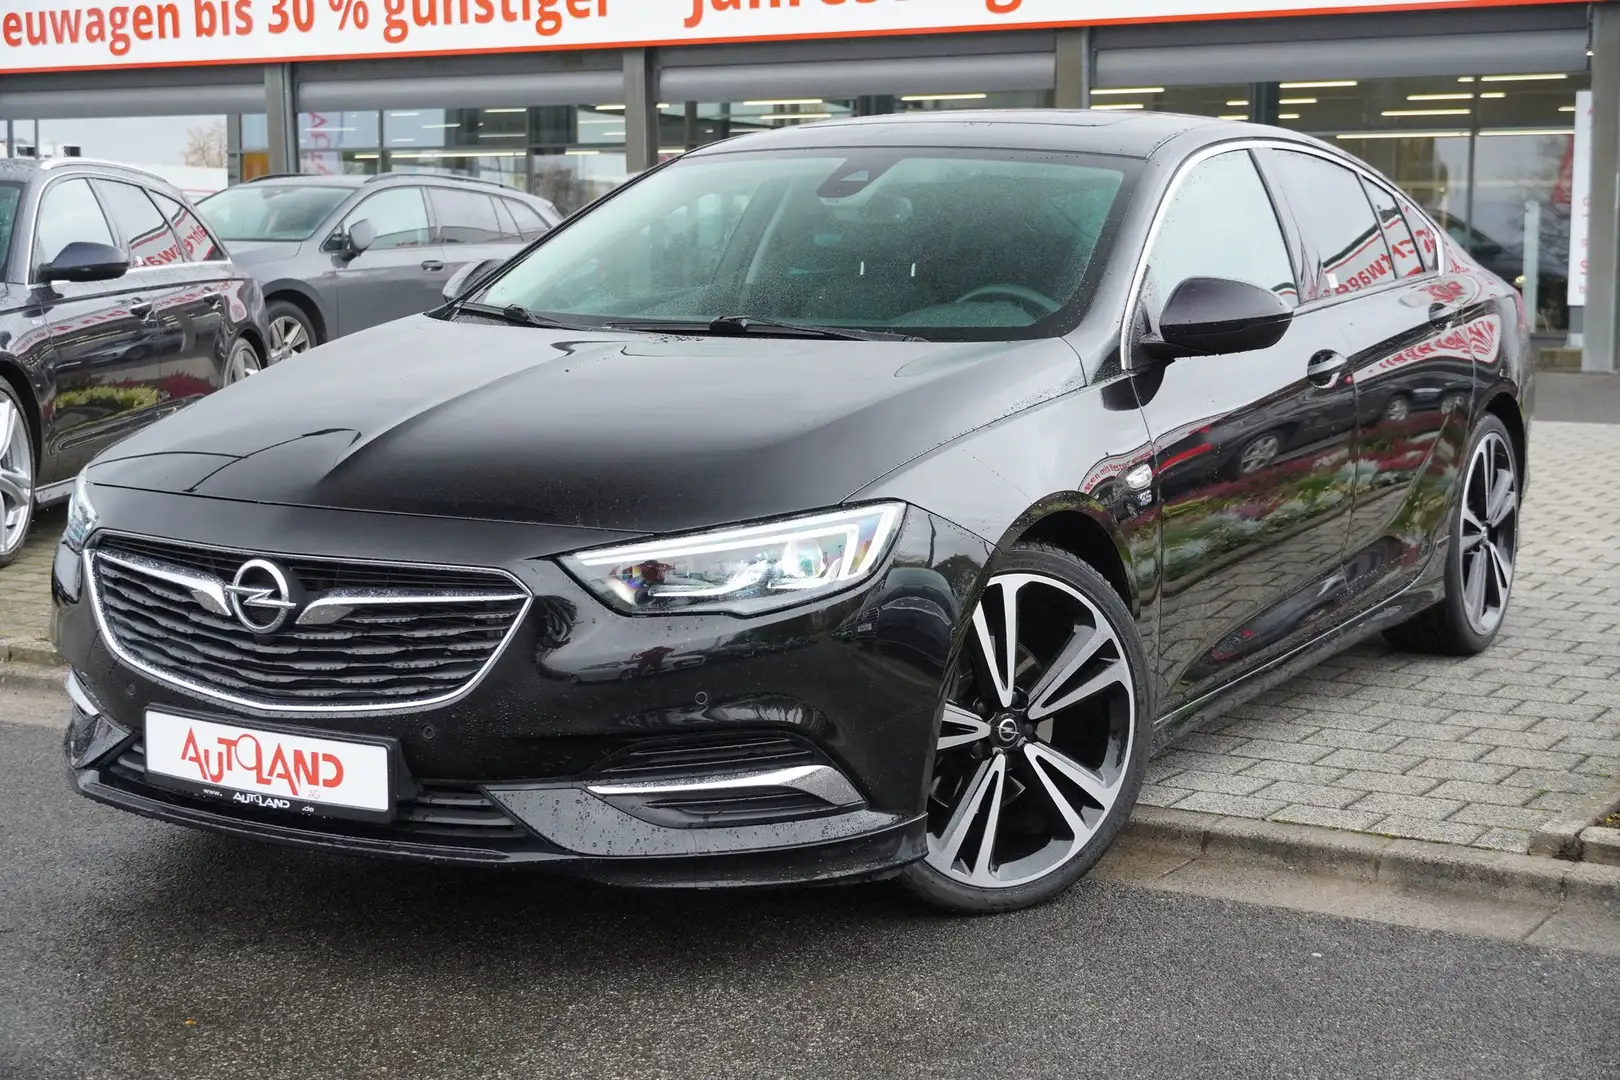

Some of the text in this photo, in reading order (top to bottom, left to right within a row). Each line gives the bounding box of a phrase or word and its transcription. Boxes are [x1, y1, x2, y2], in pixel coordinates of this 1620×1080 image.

[2, 2, 180, 56] euwagen
[193, 0, 254, 37] bis
[267, 0, 315, 34] 30
[181, 726, 344, 796] AUTOLAND
[203, 788, 223, 797] www.
[233, 792, 290, 808] AUTOLAND
[308, 789, 321, 799] AG
